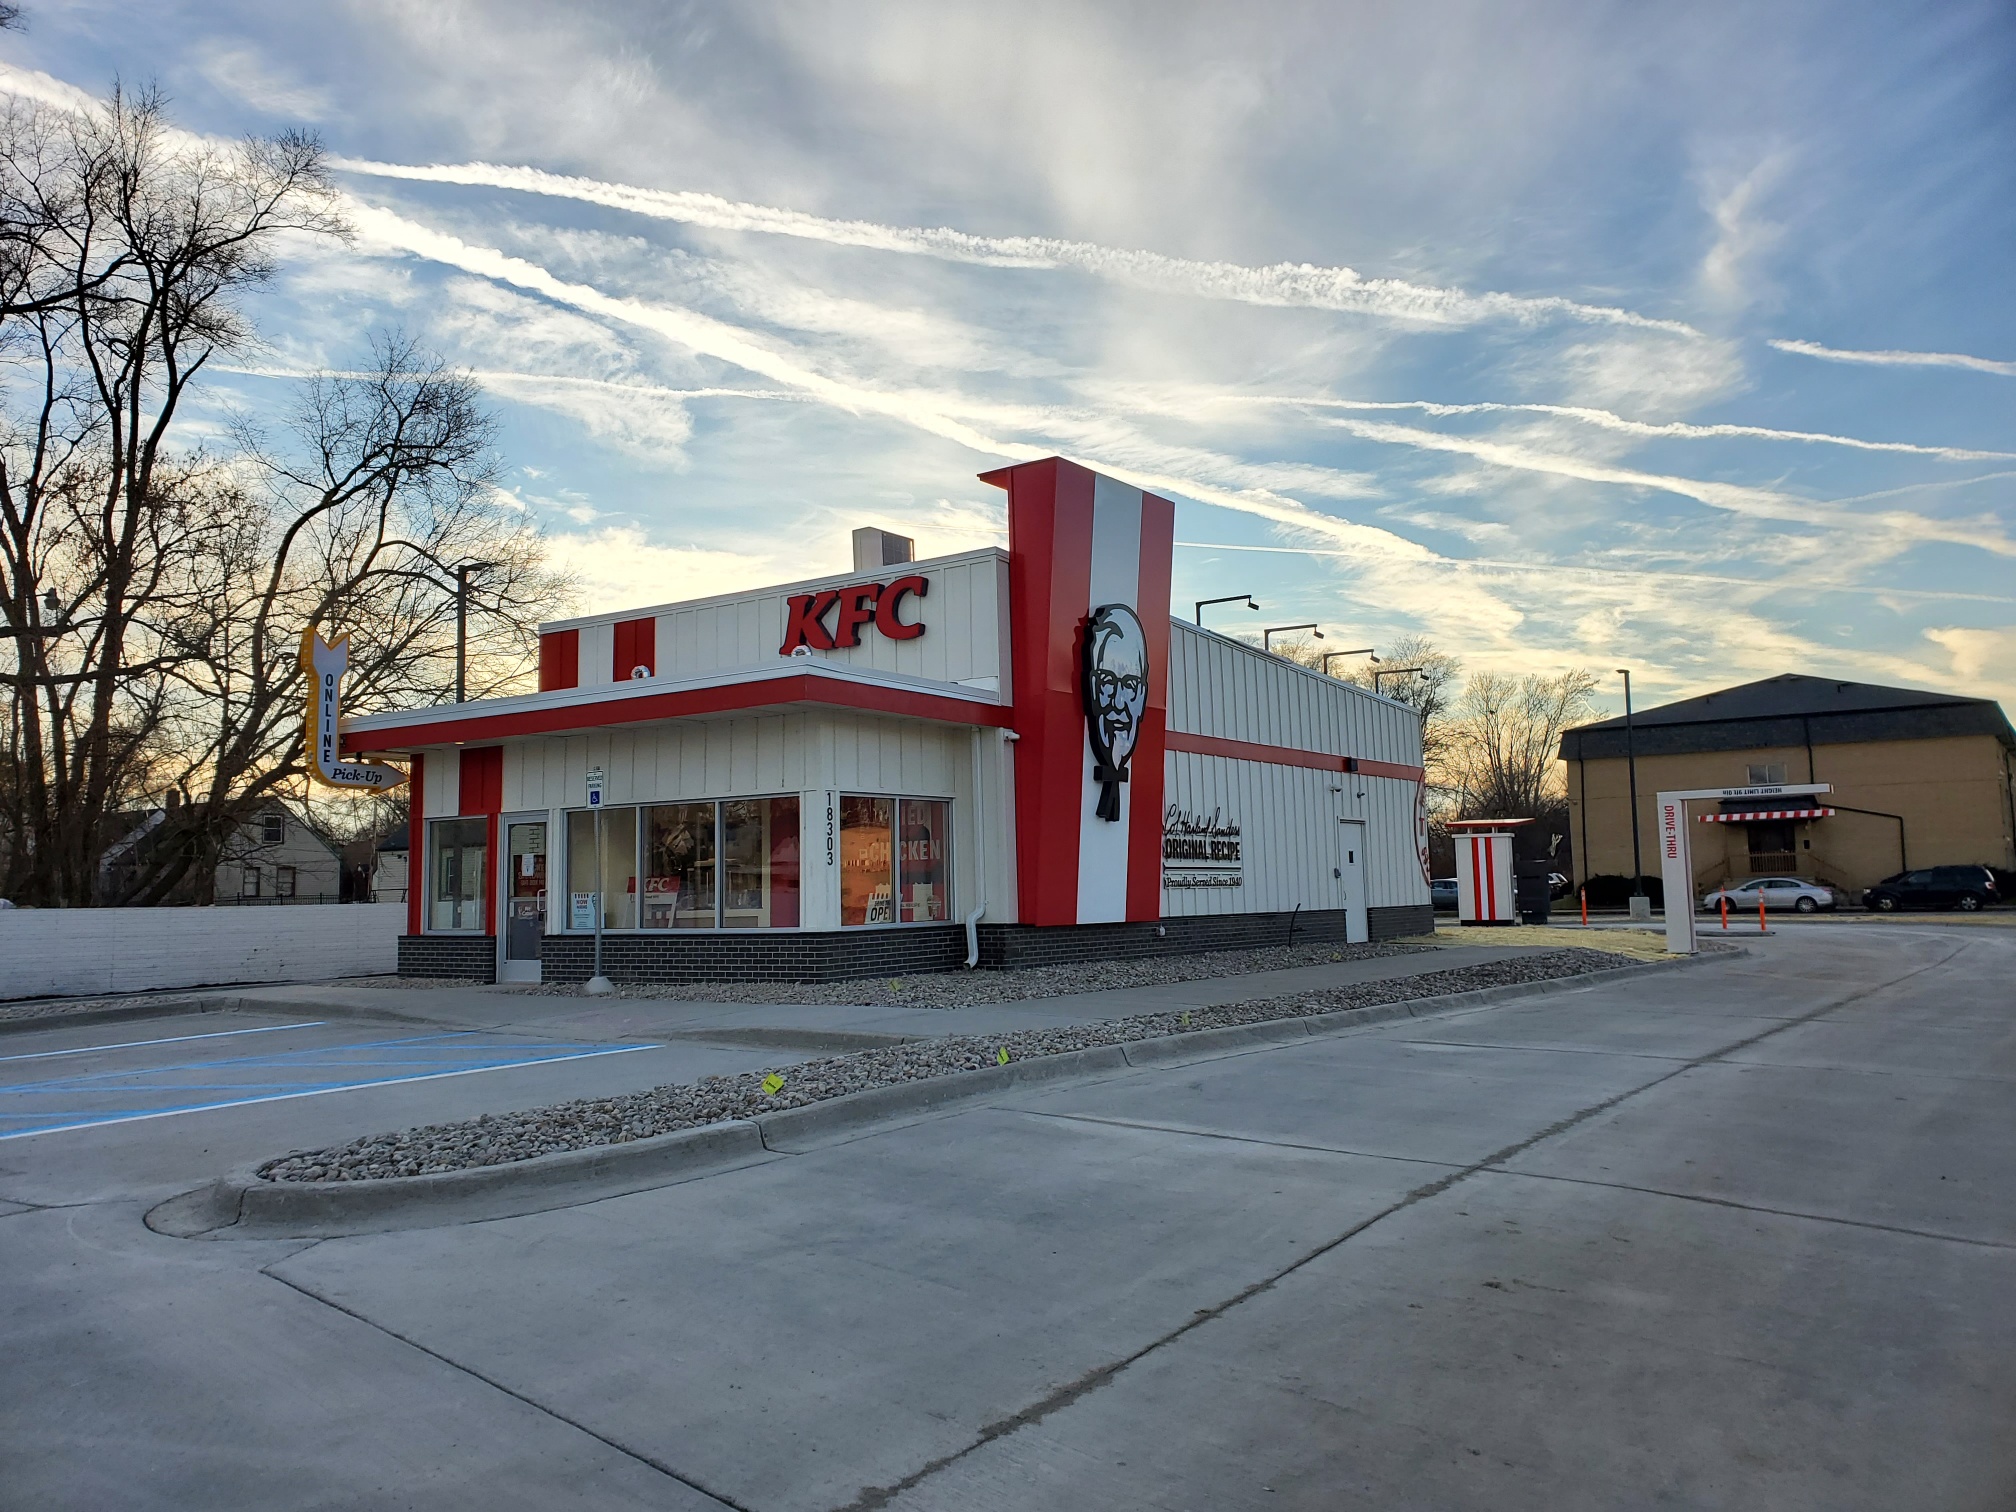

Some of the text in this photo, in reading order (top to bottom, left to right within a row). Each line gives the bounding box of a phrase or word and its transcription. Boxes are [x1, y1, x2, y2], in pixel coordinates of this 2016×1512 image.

[779, 576, 929, 656] KFC
[323, 673, 334, 763] ONLINE
[331, 768, 382, 785] Pick-Up
[826, 792, 834, 866] 18303
[1164, 838, 1241, 861] ORIGINAL RECIPE
[1664, 804, 1677, 859] DRIVE-THRU
[1166, 877, 1192, 889] Proudly
[1192, 876, 1212, 887] Served
[1213, 876, 1229, 887] Since
